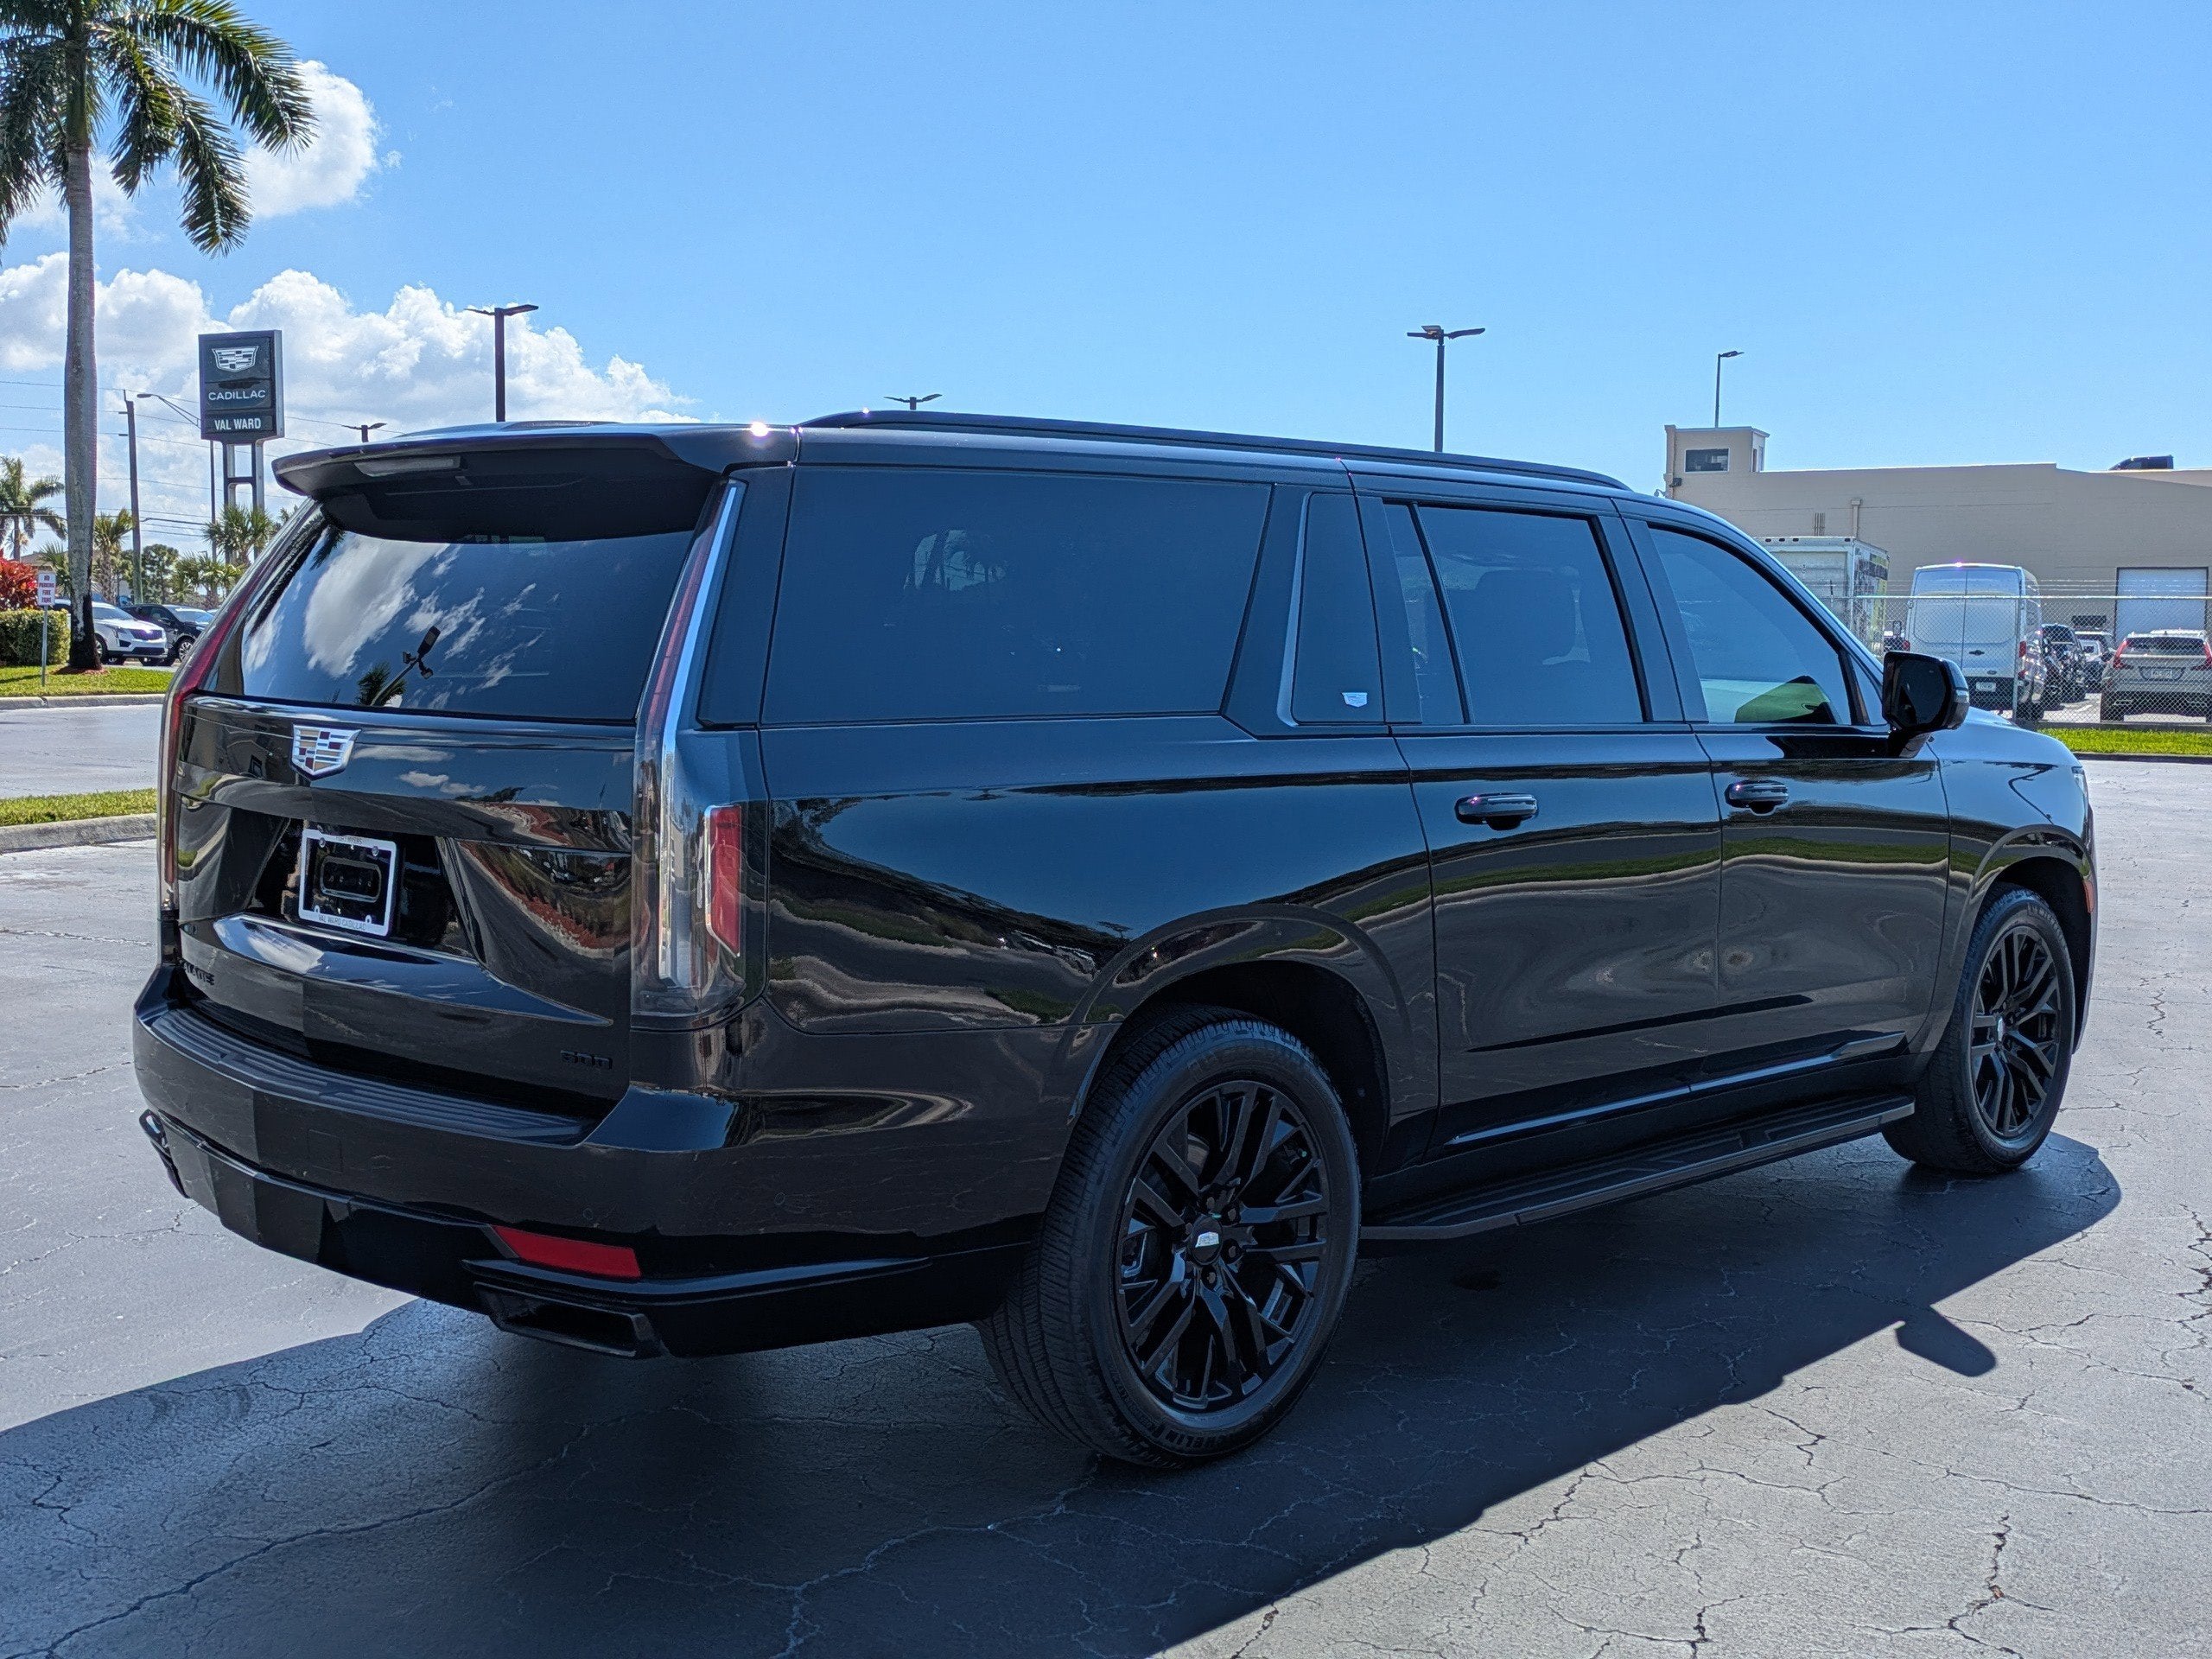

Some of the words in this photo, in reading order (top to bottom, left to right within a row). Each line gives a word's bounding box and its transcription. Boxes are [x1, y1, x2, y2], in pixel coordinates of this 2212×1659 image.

[208, 390, 266, 401] CADILLAC
[214, 419, 232, 430] VAL
[233, 418, 262, 429] WARD
[328, 917, 341, 925] WARD
[342, 919, 366, 931] CADILLAC
